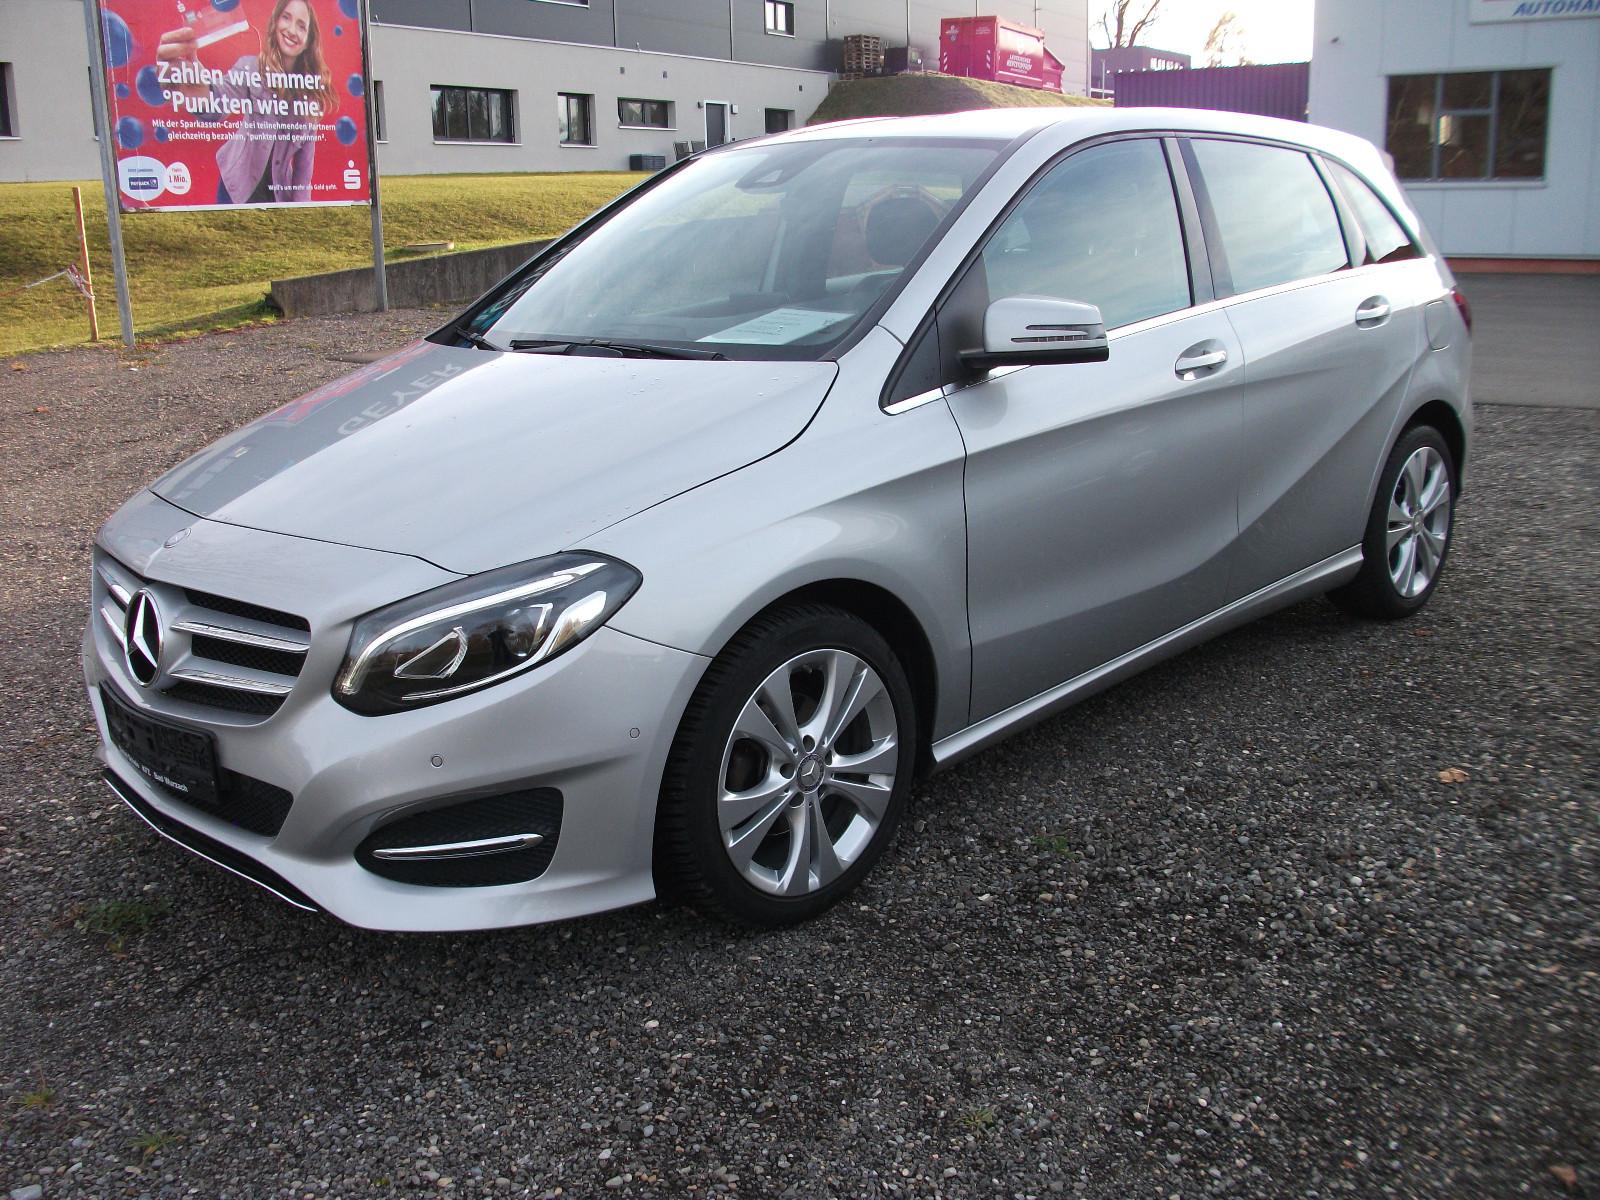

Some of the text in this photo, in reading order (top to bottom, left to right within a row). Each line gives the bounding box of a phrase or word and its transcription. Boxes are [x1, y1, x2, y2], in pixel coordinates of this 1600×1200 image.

[156, 61, 325, 90] Zahlen wie immer.
[257, 94, 289, 116] wie
[293, 96, 324, 117] nie.
[152, 119, 165, 128] Mit
[166, 119, 179, 128] der
[244, 120, 256, 129] bei
[256, 121, 307, 130] teilnehmenden
[308, 122, 336, 131] Partnern
[167, 131, 211, 142] gleichzeitig
[212, 132, 246, 141] bezahlen,
[278, 133, 291, 141] und
